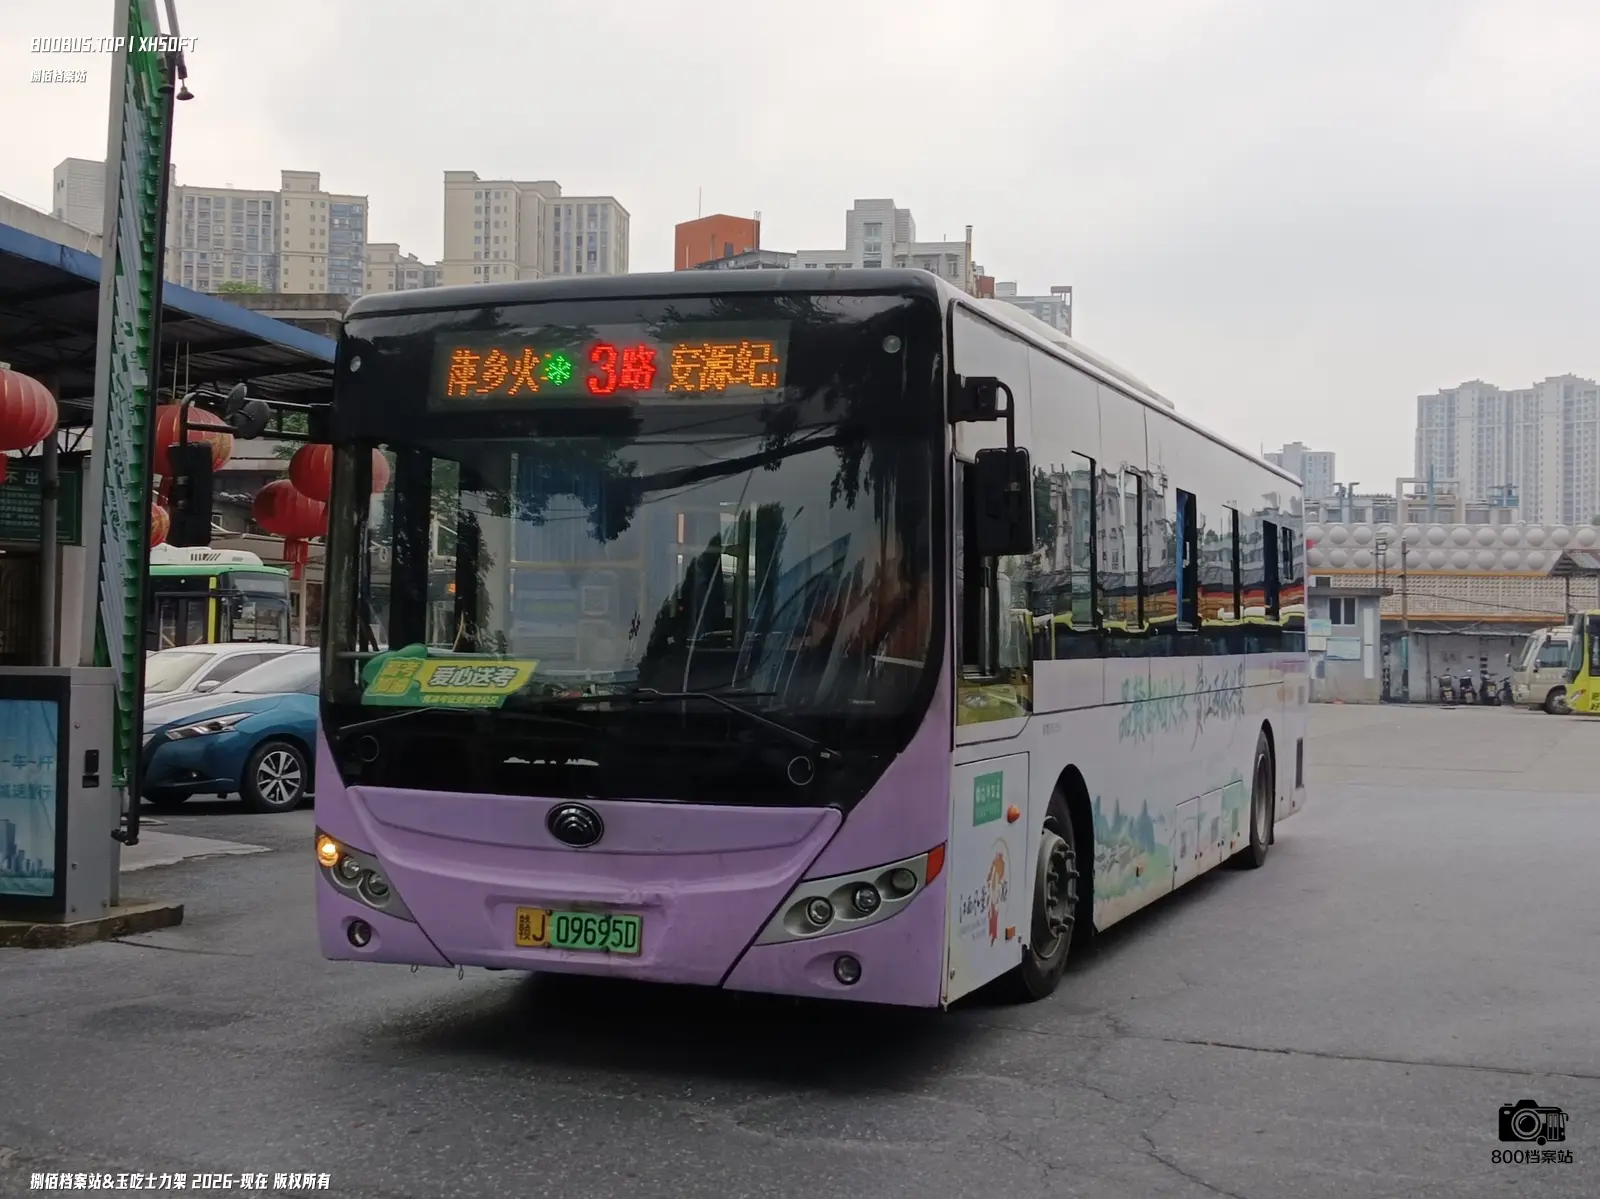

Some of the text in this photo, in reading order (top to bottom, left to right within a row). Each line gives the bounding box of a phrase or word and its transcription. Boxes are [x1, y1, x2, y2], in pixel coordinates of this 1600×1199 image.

[447, 340, 779, 396] 萍乡火 3路 安源纪
[429, 666, 518, 688] 爱心送考
